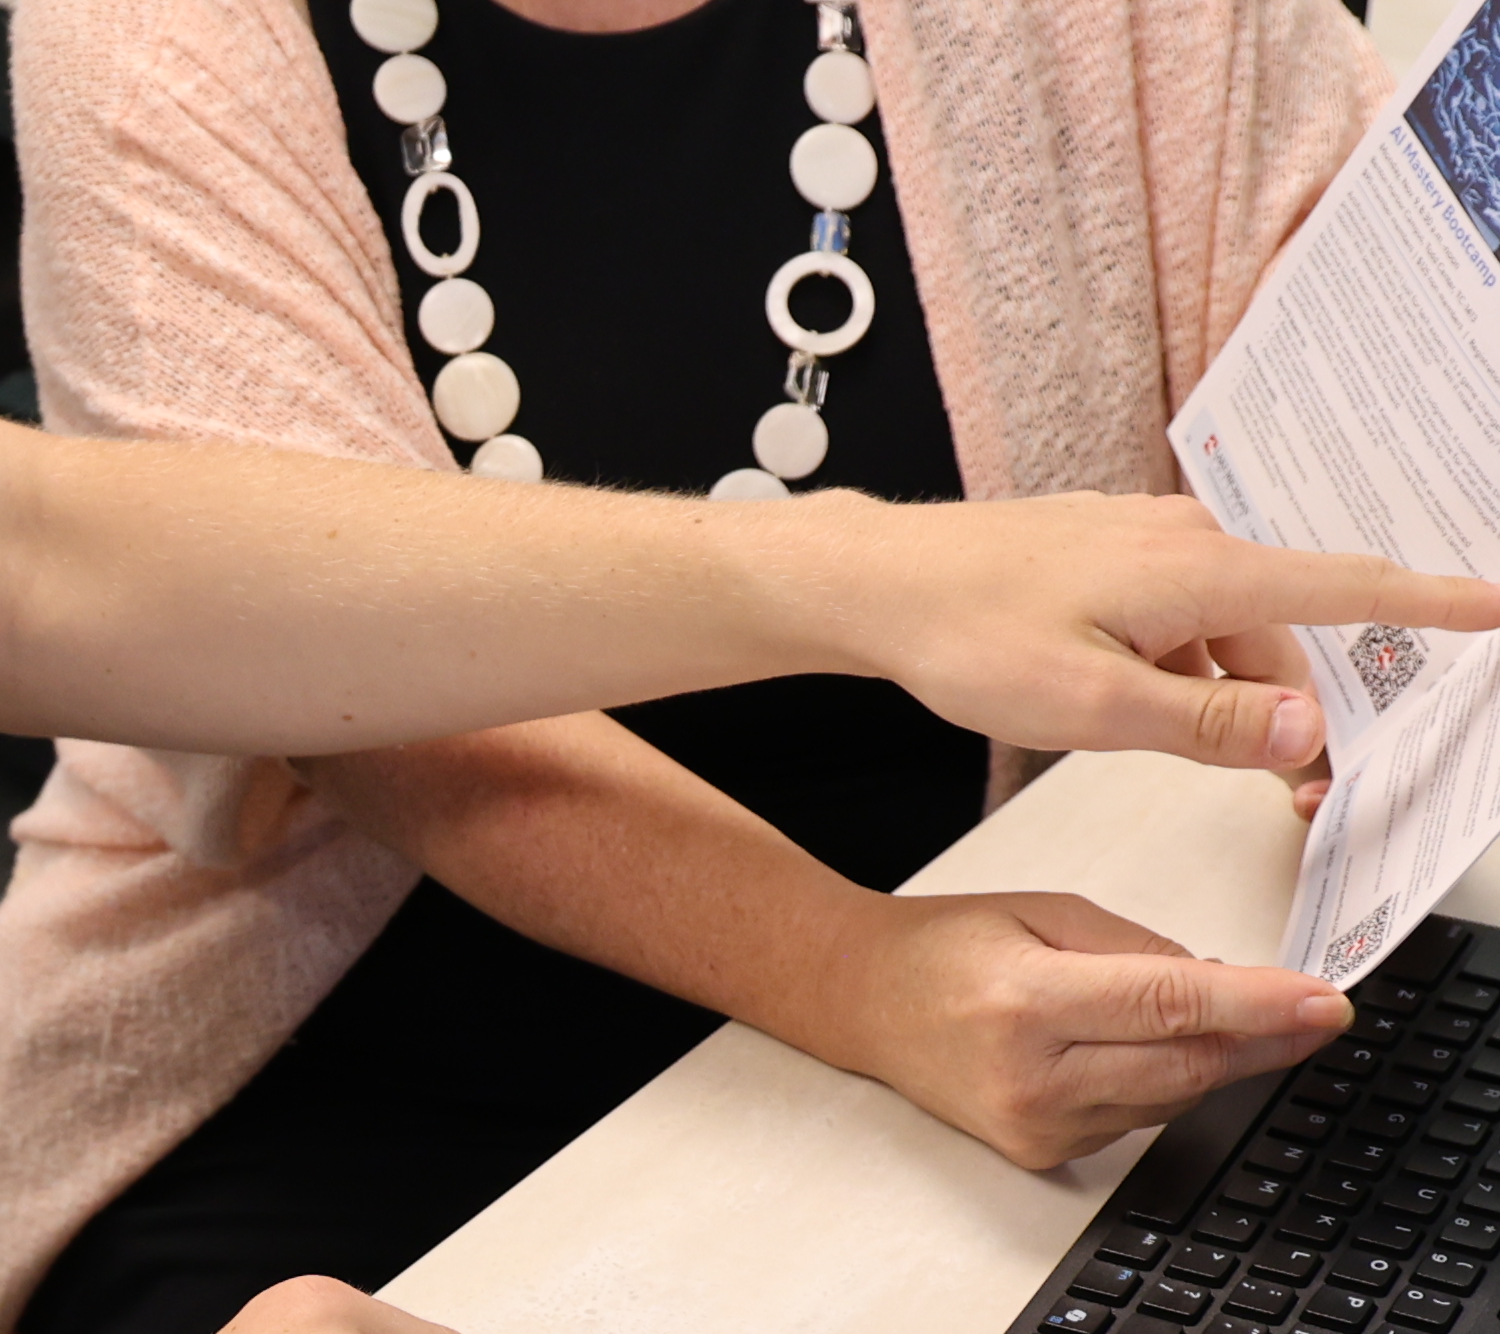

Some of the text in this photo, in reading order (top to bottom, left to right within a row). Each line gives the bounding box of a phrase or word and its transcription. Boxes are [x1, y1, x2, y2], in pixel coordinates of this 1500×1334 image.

[1389, 125, 1496, 287] AI Mastery Bootcamp
[1453, 468, 1498, 533] breakthroughs
[1397, 989, 1416, 1000] Z
[1376, 1018, 1395, 1029] X
[1353, 1050, 1372, 1061] C
[1332, 1082, 1351, 1093] V
[1413, 1079, 1429, 1091] F
[1308, 1114, 1327, 1124] B
[1387, 1113, 1406, 1124] G
[1463, 1121, 1481, 1132] T
[1284, 1147, 1304, 1159] N
[1363, 1146, 1384, 1157] H
[1441, 1154, 1460, 1166] Y
[1259, 1180, 1280, 1194] M
[1341, 1180, 1359, 1191] J
[1478, 1181, 1494, 1194] 7
[1417, 1188, 1438, 1200] U
[1315, 1213, 1337, 1226] K
[1454, 1216, 1472, 1227] 8
[1141, 1232, 1159, 1247] Alt
[1290, 1250, 1312, 1260] L
[1431, 1251, 1449, 1264] 9
[1118, 1268, 1134, 1280] Fn
[1347, 1295, 1366, 1308] P
